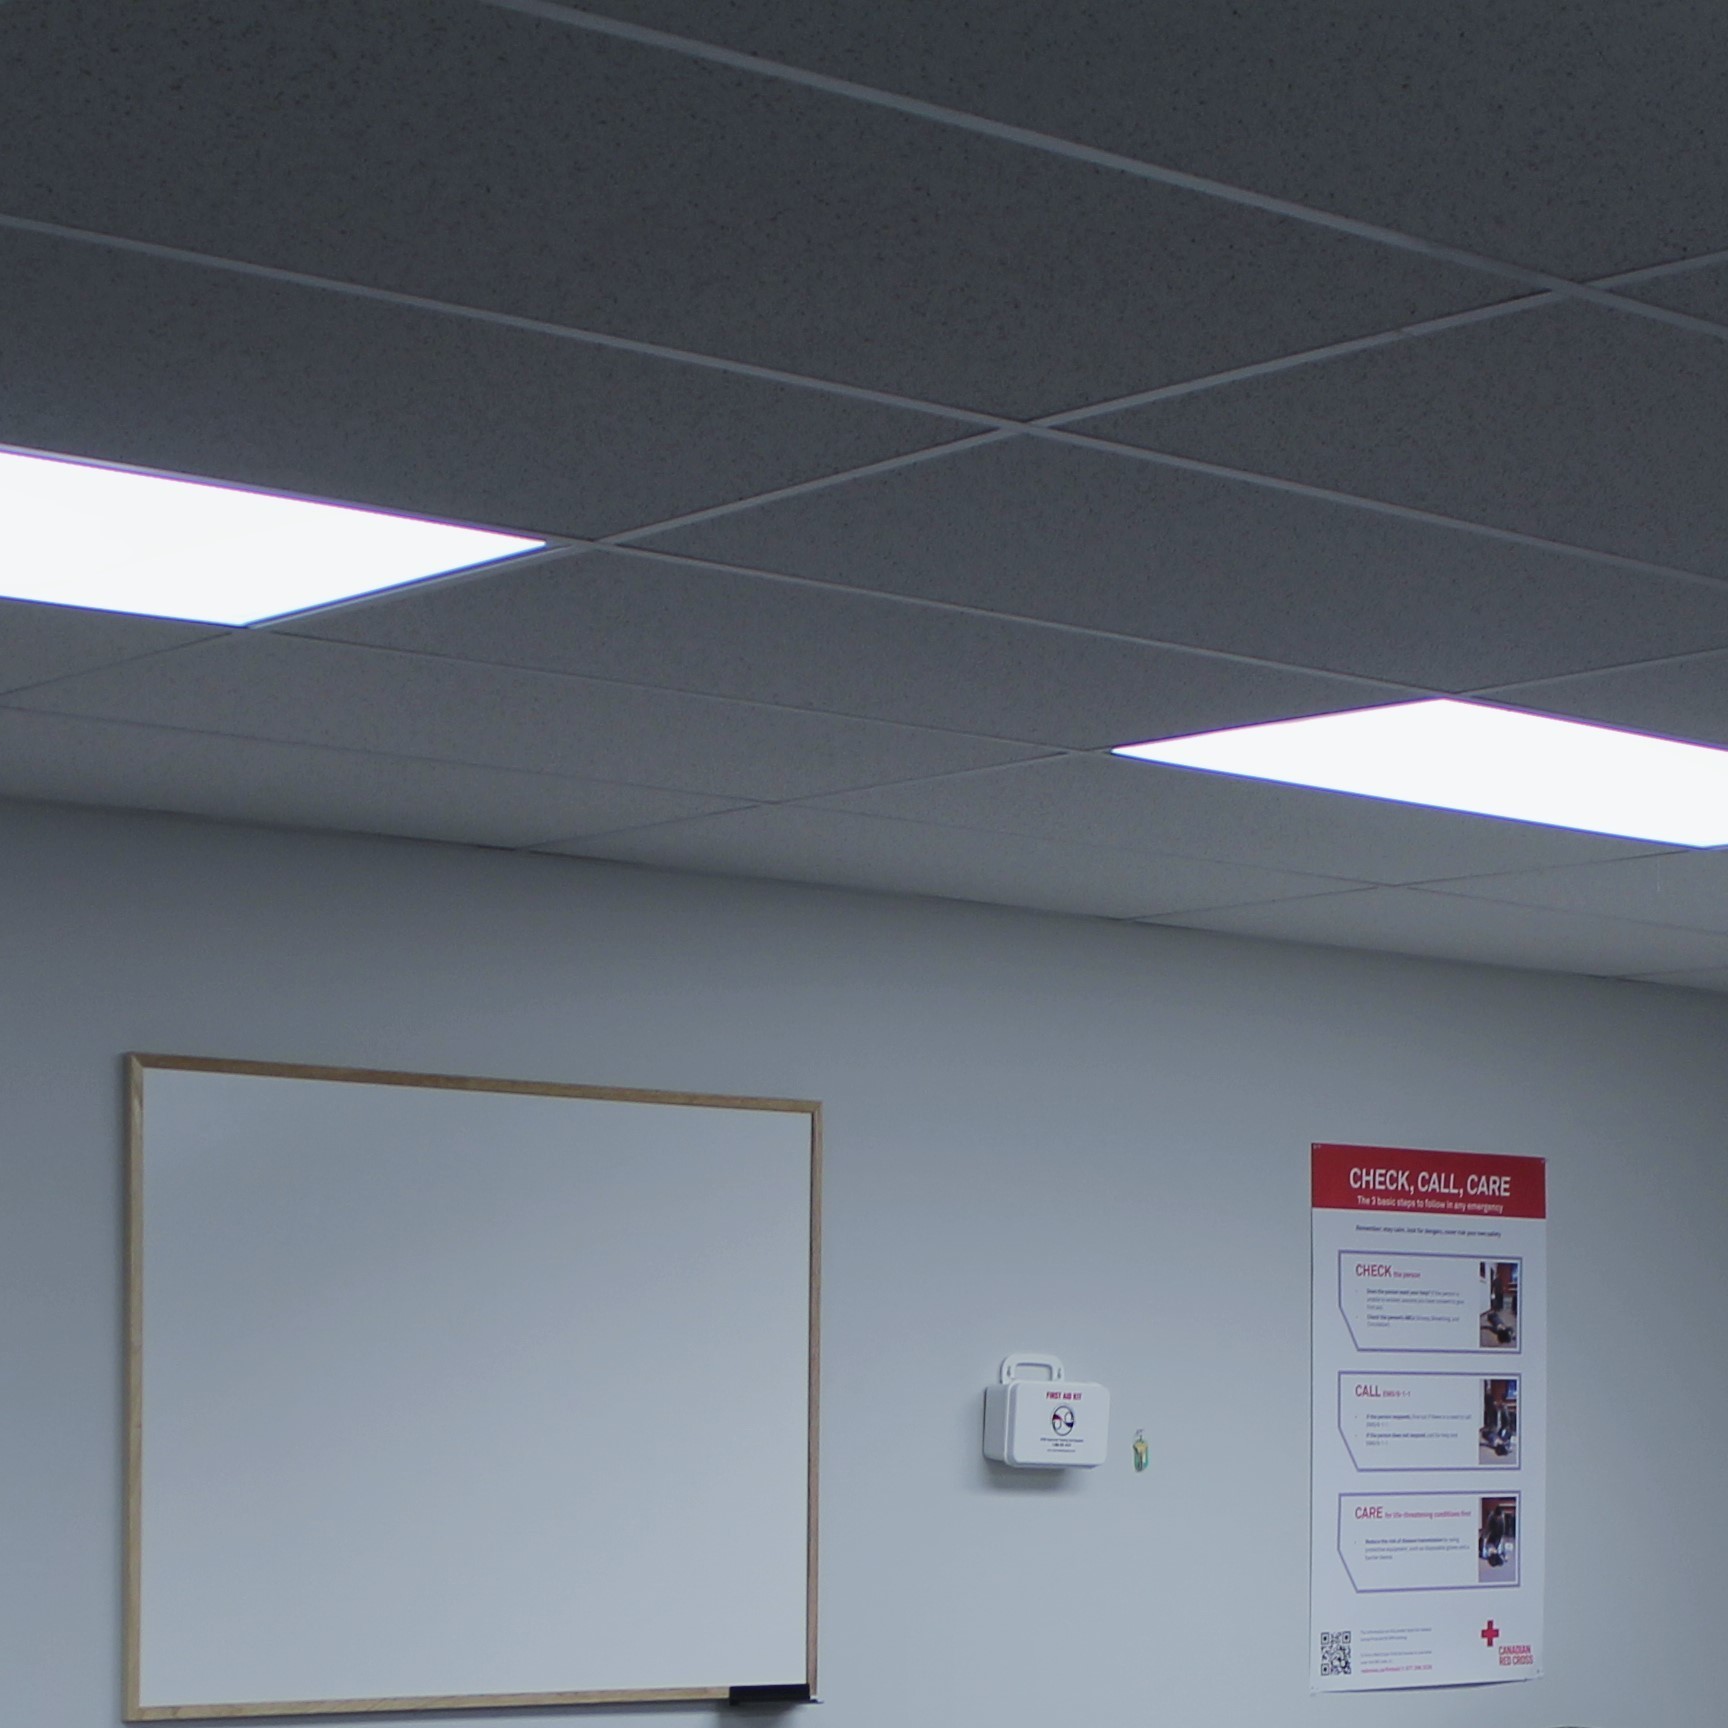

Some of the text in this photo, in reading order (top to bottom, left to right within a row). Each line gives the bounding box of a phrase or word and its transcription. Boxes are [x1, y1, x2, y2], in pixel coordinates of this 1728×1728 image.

[1349, 1167, 1511, 1198] CHECK, CALL, CARE
[1357, 1195, 1503, 1214] The 3 basic steps to follow in any emergency
[1355, 1263, 1392, 1277] CHECK
[1046, 1391, 1082, 1400] FIRST AID KIT
[1355, 1384, 1381, 1397] CALL
[1355, 1506, 1383, 1519] CARE
[1498, 1645, 1531, 1655] CANADIAN
[1499, 1655, 1533, 1666] RED CROSS
